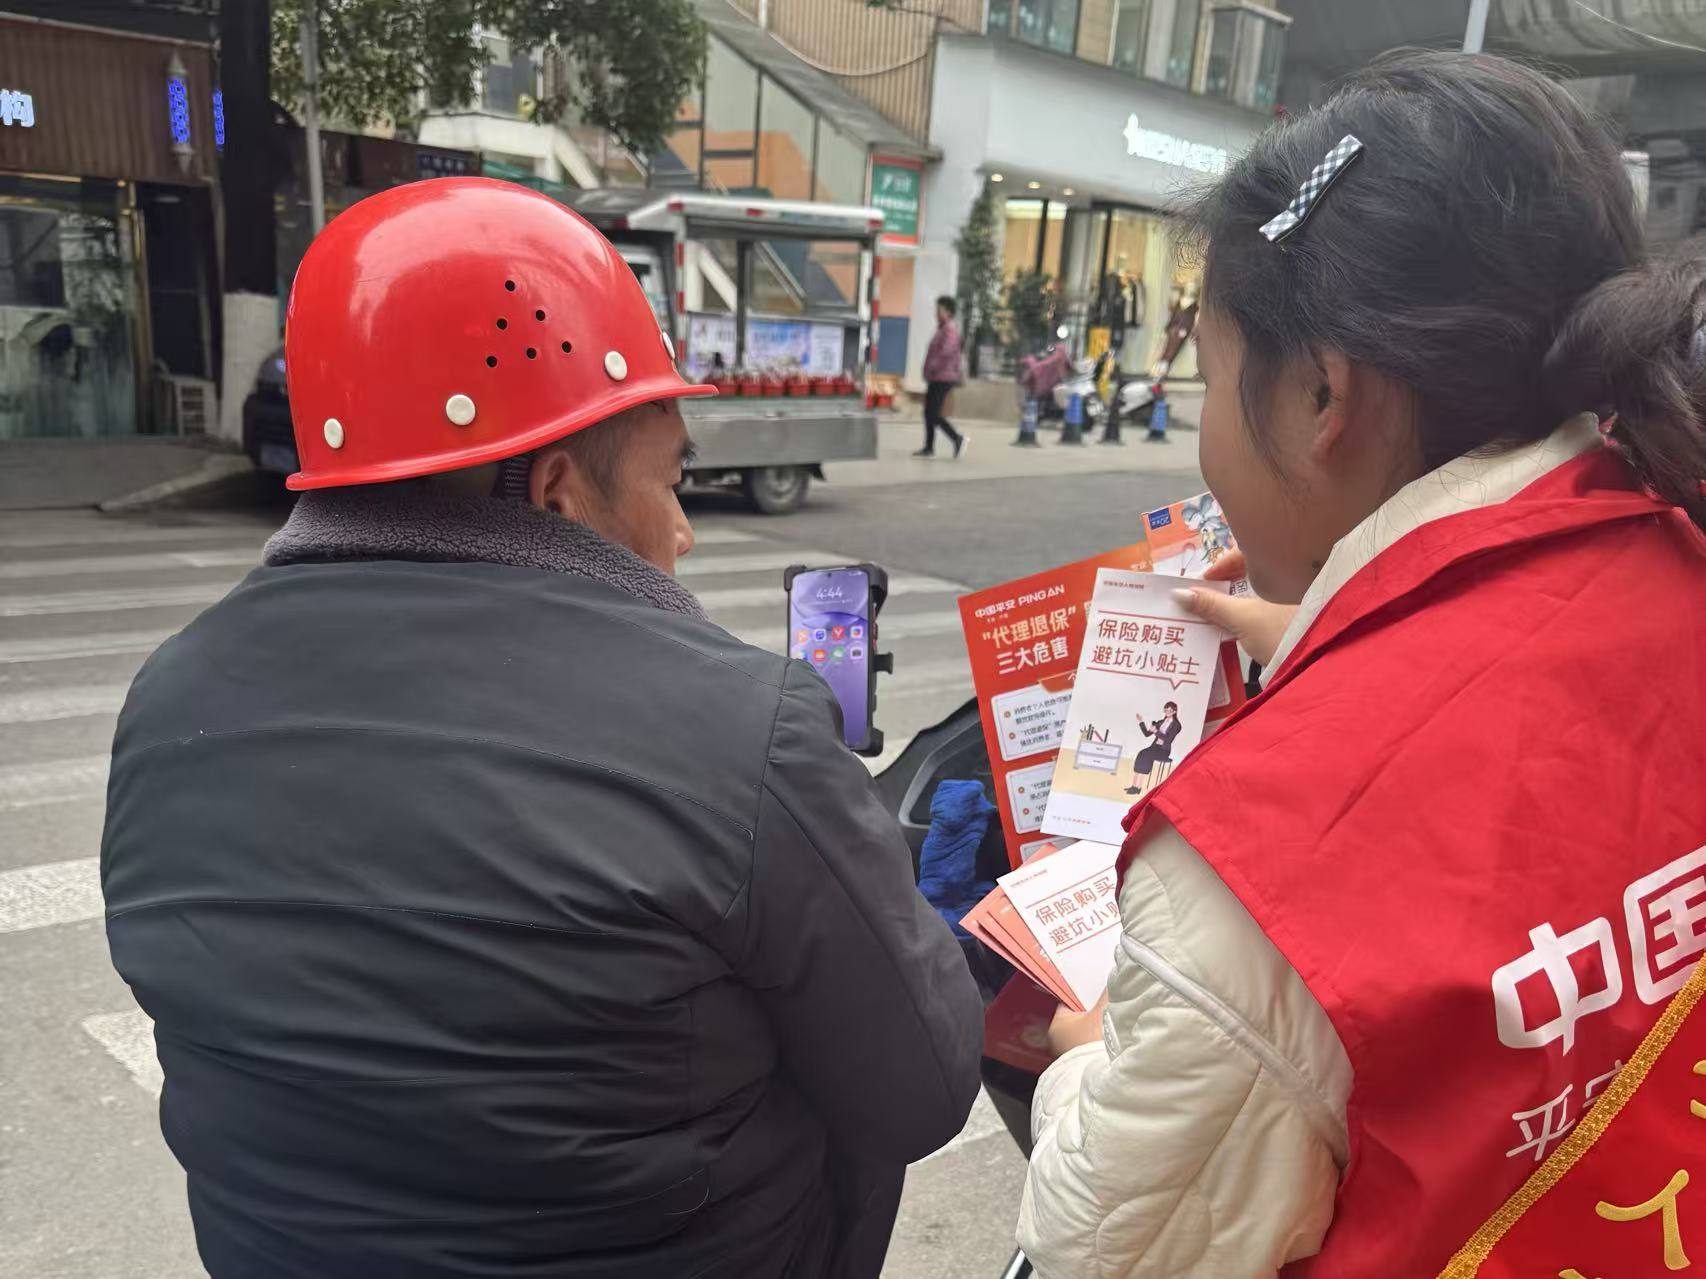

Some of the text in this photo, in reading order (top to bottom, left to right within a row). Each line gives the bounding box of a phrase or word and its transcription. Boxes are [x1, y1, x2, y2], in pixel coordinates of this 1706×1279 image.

[816, 586, 842, 599] 4:44
[975, 599, 1015, 618] 中国平安
[1098, 619, 1185, 647] 保险购买
[996, 636, 1069, 674] 三大危害
[1091, 645, 1200, 675] 避坑小贴士
[1035, 876, 1116, 926] 保险购买
